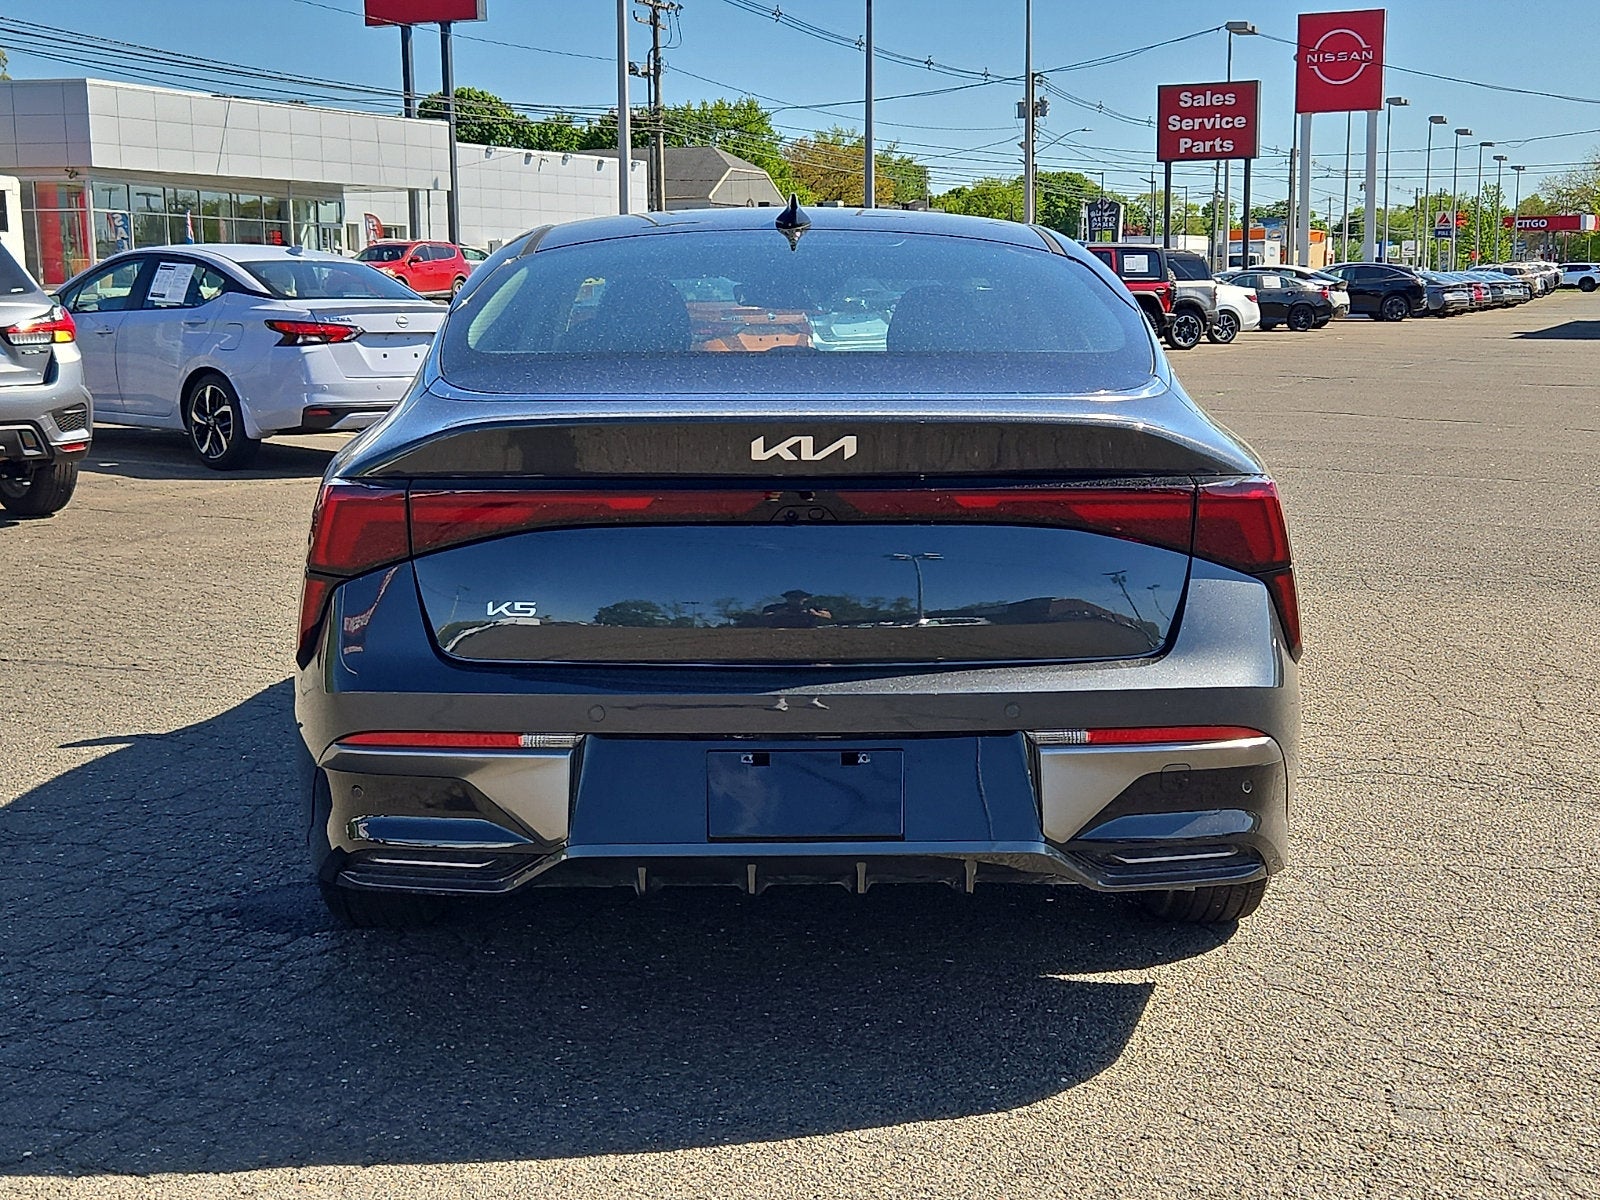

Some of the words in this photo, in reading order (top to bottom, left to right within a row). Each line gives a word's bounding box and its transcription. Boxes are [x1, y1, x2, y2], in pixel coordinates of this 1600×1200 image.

[1306, 50, 1373, 63] NISSAN
[1179, 91, 1236, 108] Sales
[1168, 114, 1247, 131] Service
[1179, 137, 1234, 153] Parts
[1516, 219, 1548, 228] CITGO
[487, 601, 537, 617] K5
